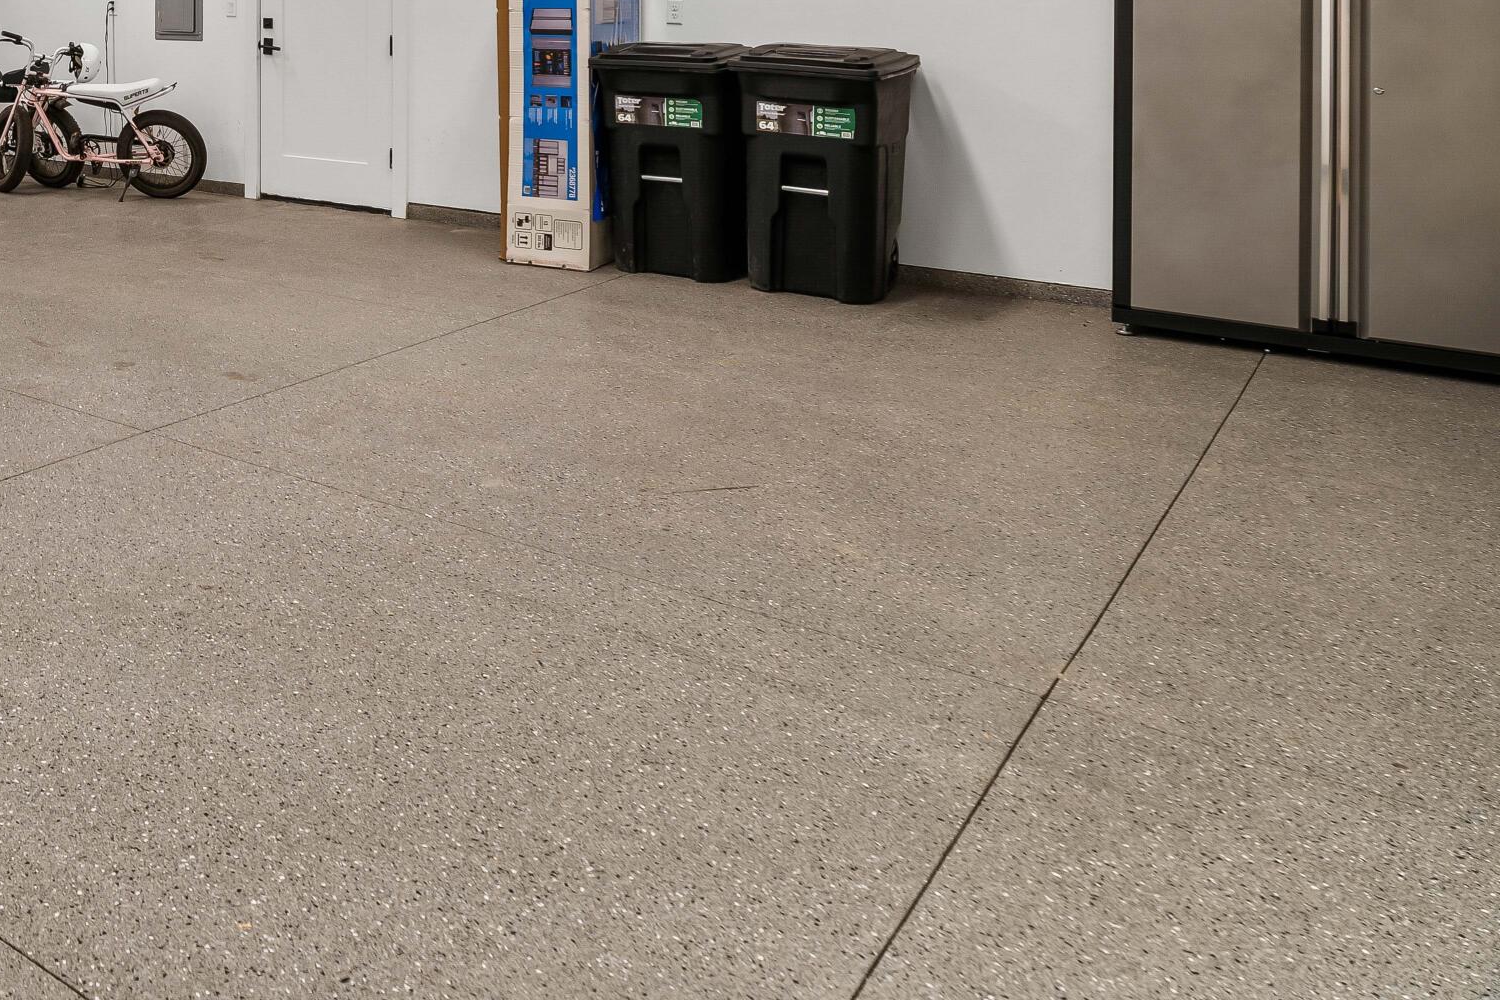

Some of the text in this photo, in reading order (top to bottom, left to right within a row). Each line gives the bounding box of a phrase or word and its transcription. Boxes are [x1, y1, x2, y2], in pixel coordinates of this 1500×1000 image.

[617, 96, 642, 105] Toter
[759, 102, 787, 112] Toter
[618, 113, 632, 122] 64
[759, 121, 775, 130] 64
